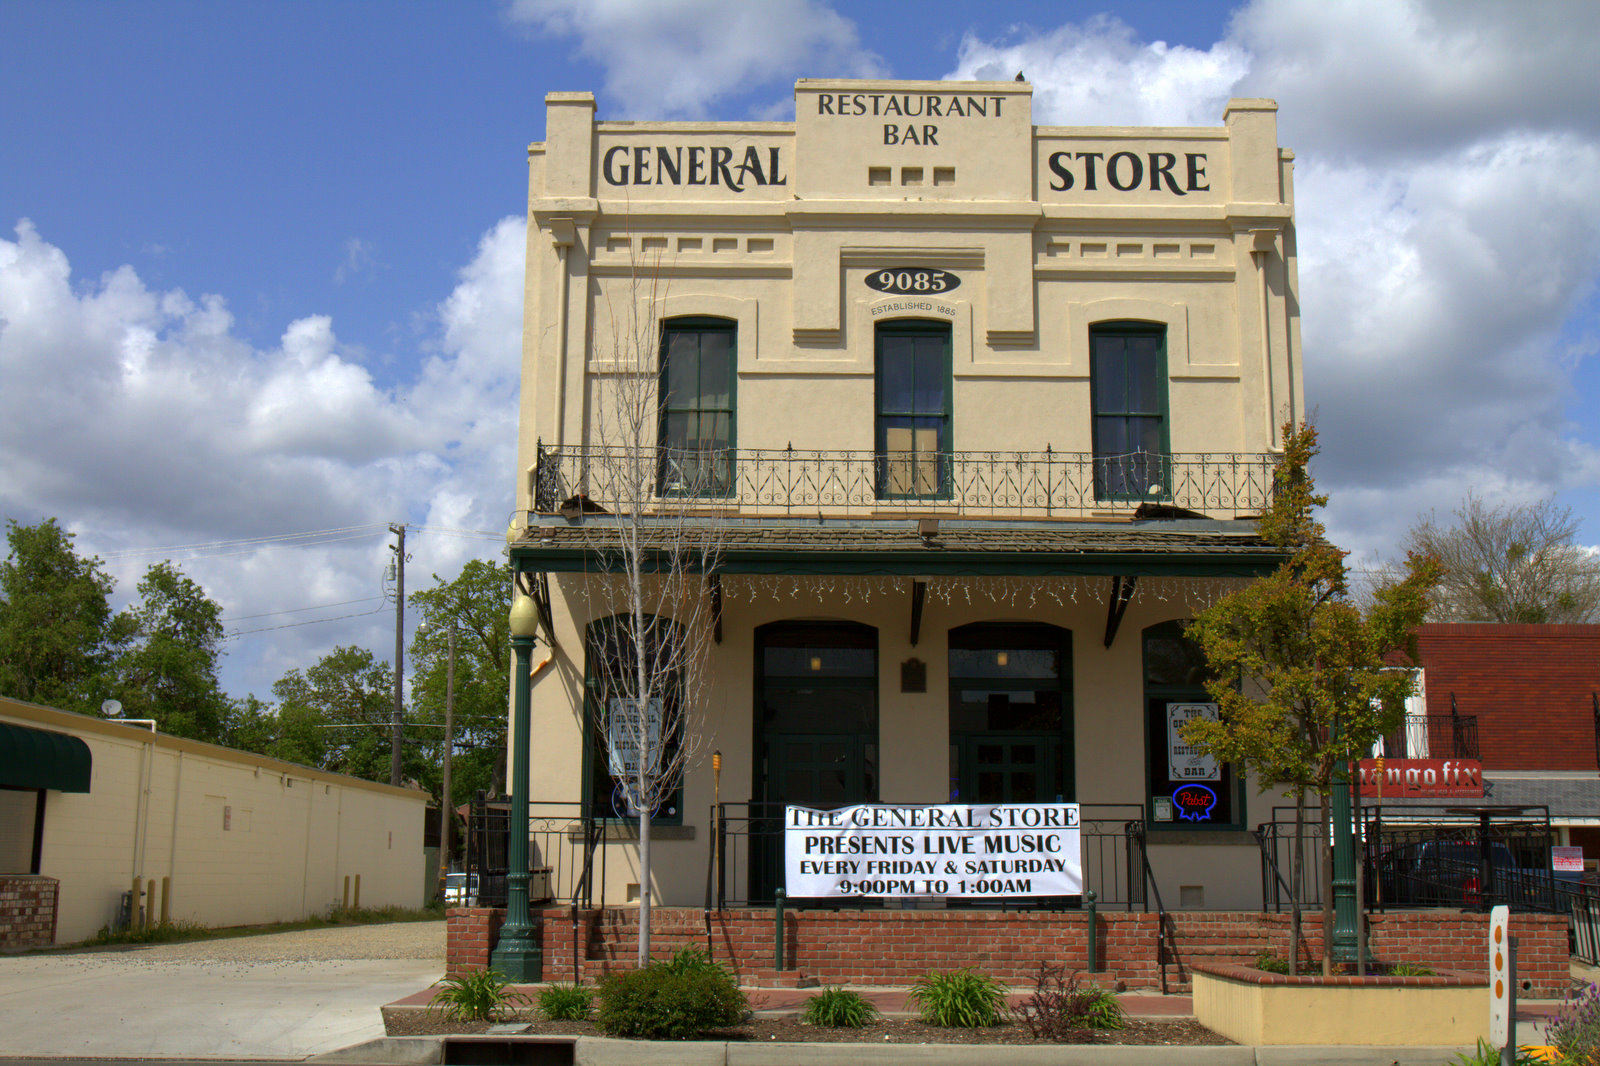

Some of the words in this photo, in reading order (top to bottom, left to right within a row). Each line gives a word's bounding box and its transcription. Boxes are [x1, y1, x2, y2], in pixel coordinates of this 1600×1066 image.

[818, 93, 1006, 118] RESTAURANT
[884, 124, 939, 146] BAR
[603, 145, 787, 193] GENERAL
[1048, 151, 1210, 196] STORE
[879, 271, 946, 291] 9085
[871, 303, 932, 316] ESTABLISHED
[937, 305, 956, 316] 1885
[1184, 767, 1205, 776] BAR
[1442, 761, 1478, 786] fix
[1181, 791, 1211, 806] Pabst
[789, 807, 843, 826] THE
[851, 807, 981, 827] GENERAL
[989, 807, 1078, 827] STORE
[805, 835, 915, 855] PRESENTS
[924, 835, 976, 854] LIVE
[984, 834, 1061, 853] MUSIC
[800, 860, 860, 875] EVERY
[867, 860, 937, 875] FRIDAY
[944, 860, 958, 875] &
[965, 859, 1066, 875] SATURDAY
[840, 879, 915, 894] 9:00PM
[922, 879, 948, 894] TO
[957, 878, 1031, 894] 1:00AM
